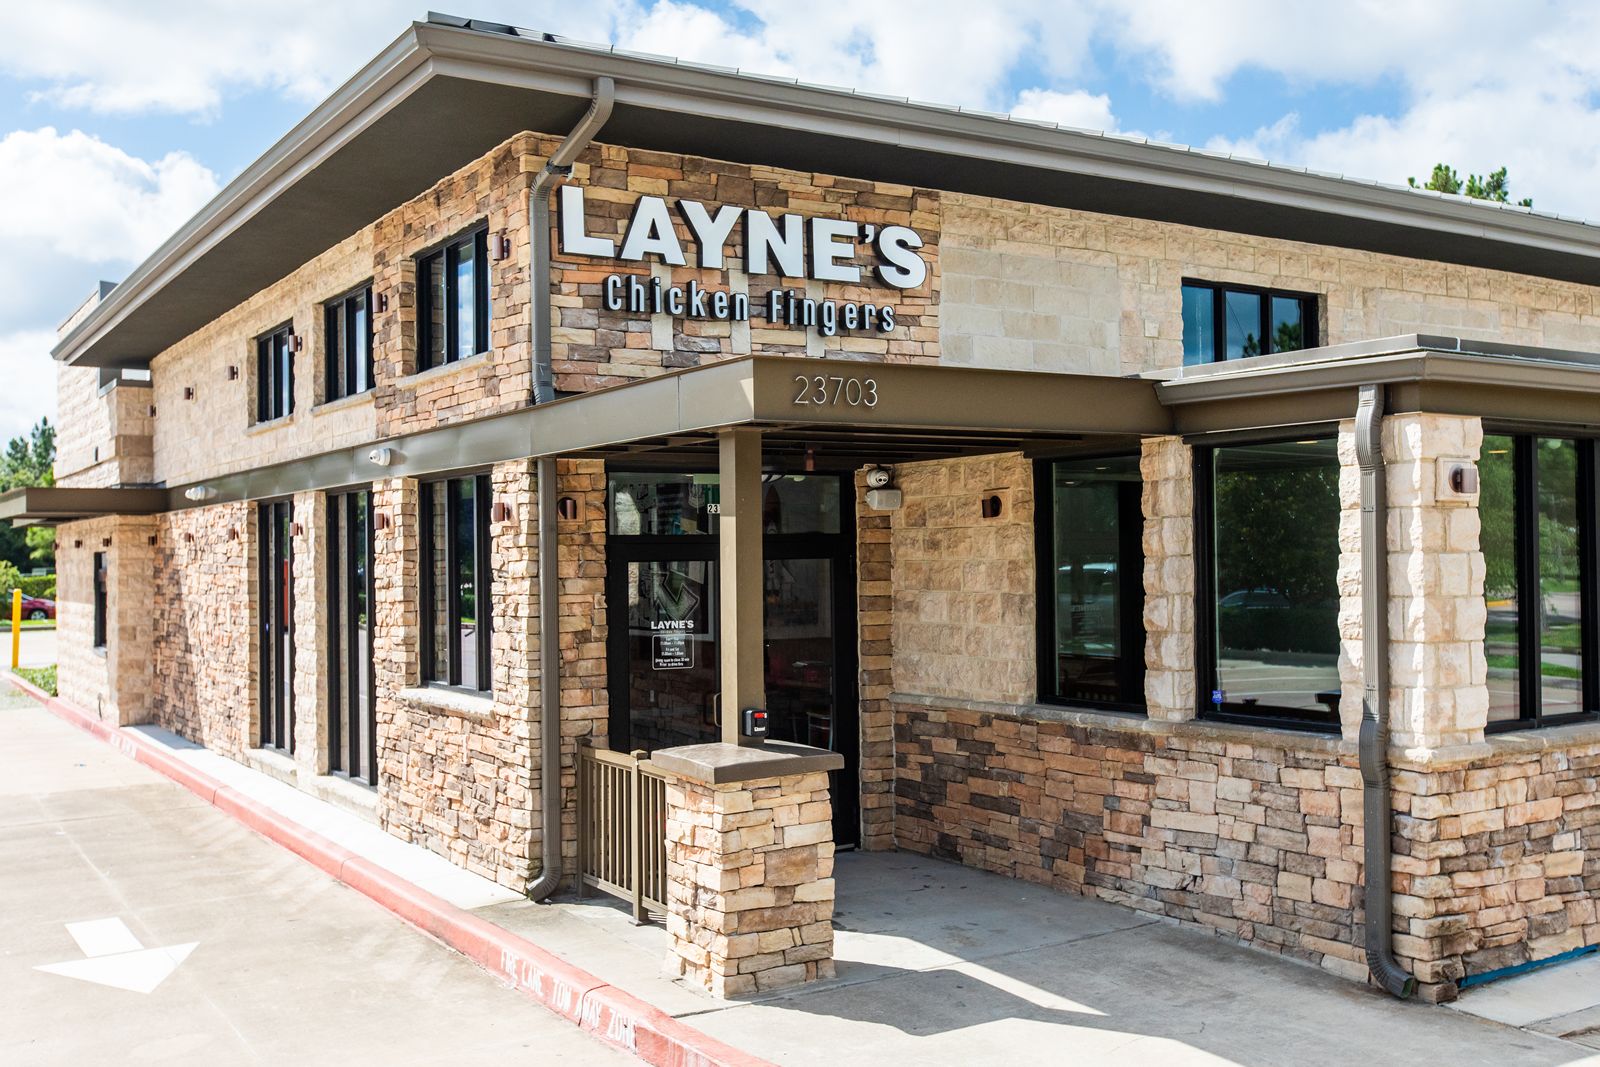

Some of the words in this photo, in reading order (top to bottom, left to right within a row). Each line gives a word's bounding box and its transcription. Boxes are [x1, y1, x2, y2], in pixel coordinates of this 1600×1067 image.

[557, 185, 927, 289] LAYNE'S
[603, 274, 749, 322] Chicken
[767, 289, 896, 337] Fingers
[793, 375, 878, 407] 23703
[650, 620, 694, 629] LAYNE'S
[501, 948, 519, 979] FIRE
[522, 960, 544, 997] LANE
[552, 977, 574, 1013] TOW
[574, 994, 603, 1027] AWAY
